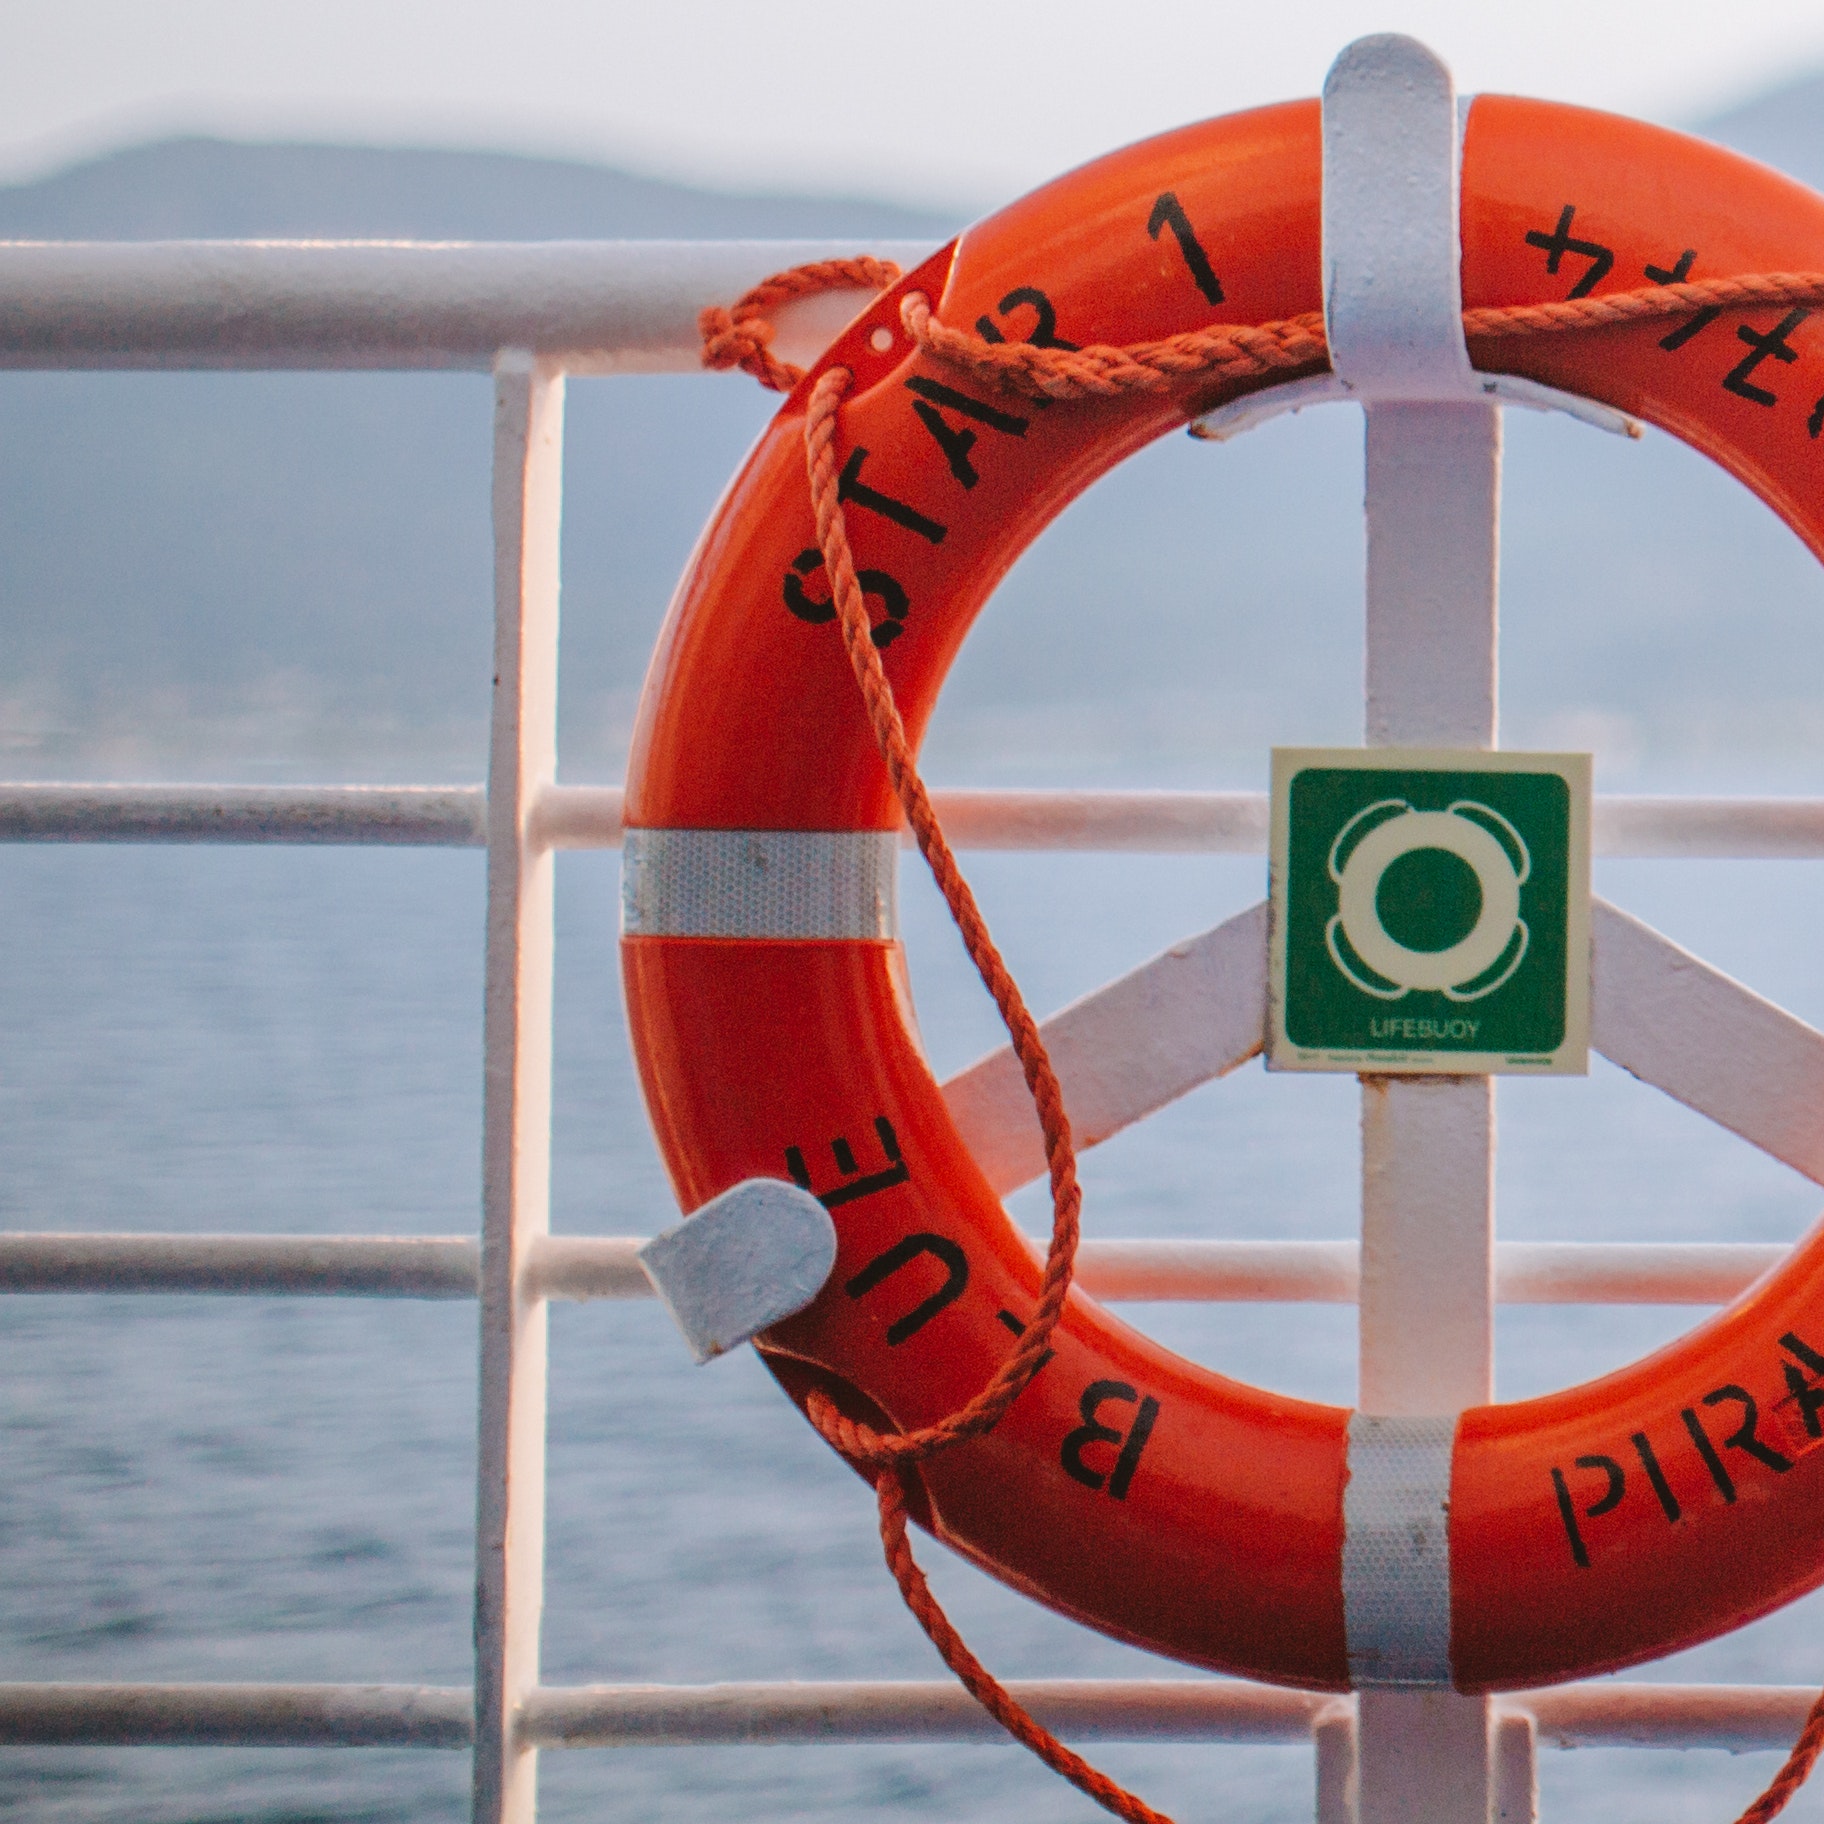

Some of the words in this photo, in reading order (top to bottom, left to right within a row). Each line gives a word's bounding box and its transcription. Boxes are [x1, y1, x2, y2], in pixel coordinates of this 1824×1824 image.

[783, 287, 1082, 649] STAR
[1147, 192, 1225, 306] 1
[1369, 1017, 1481, 1040] LIFEBUOY
